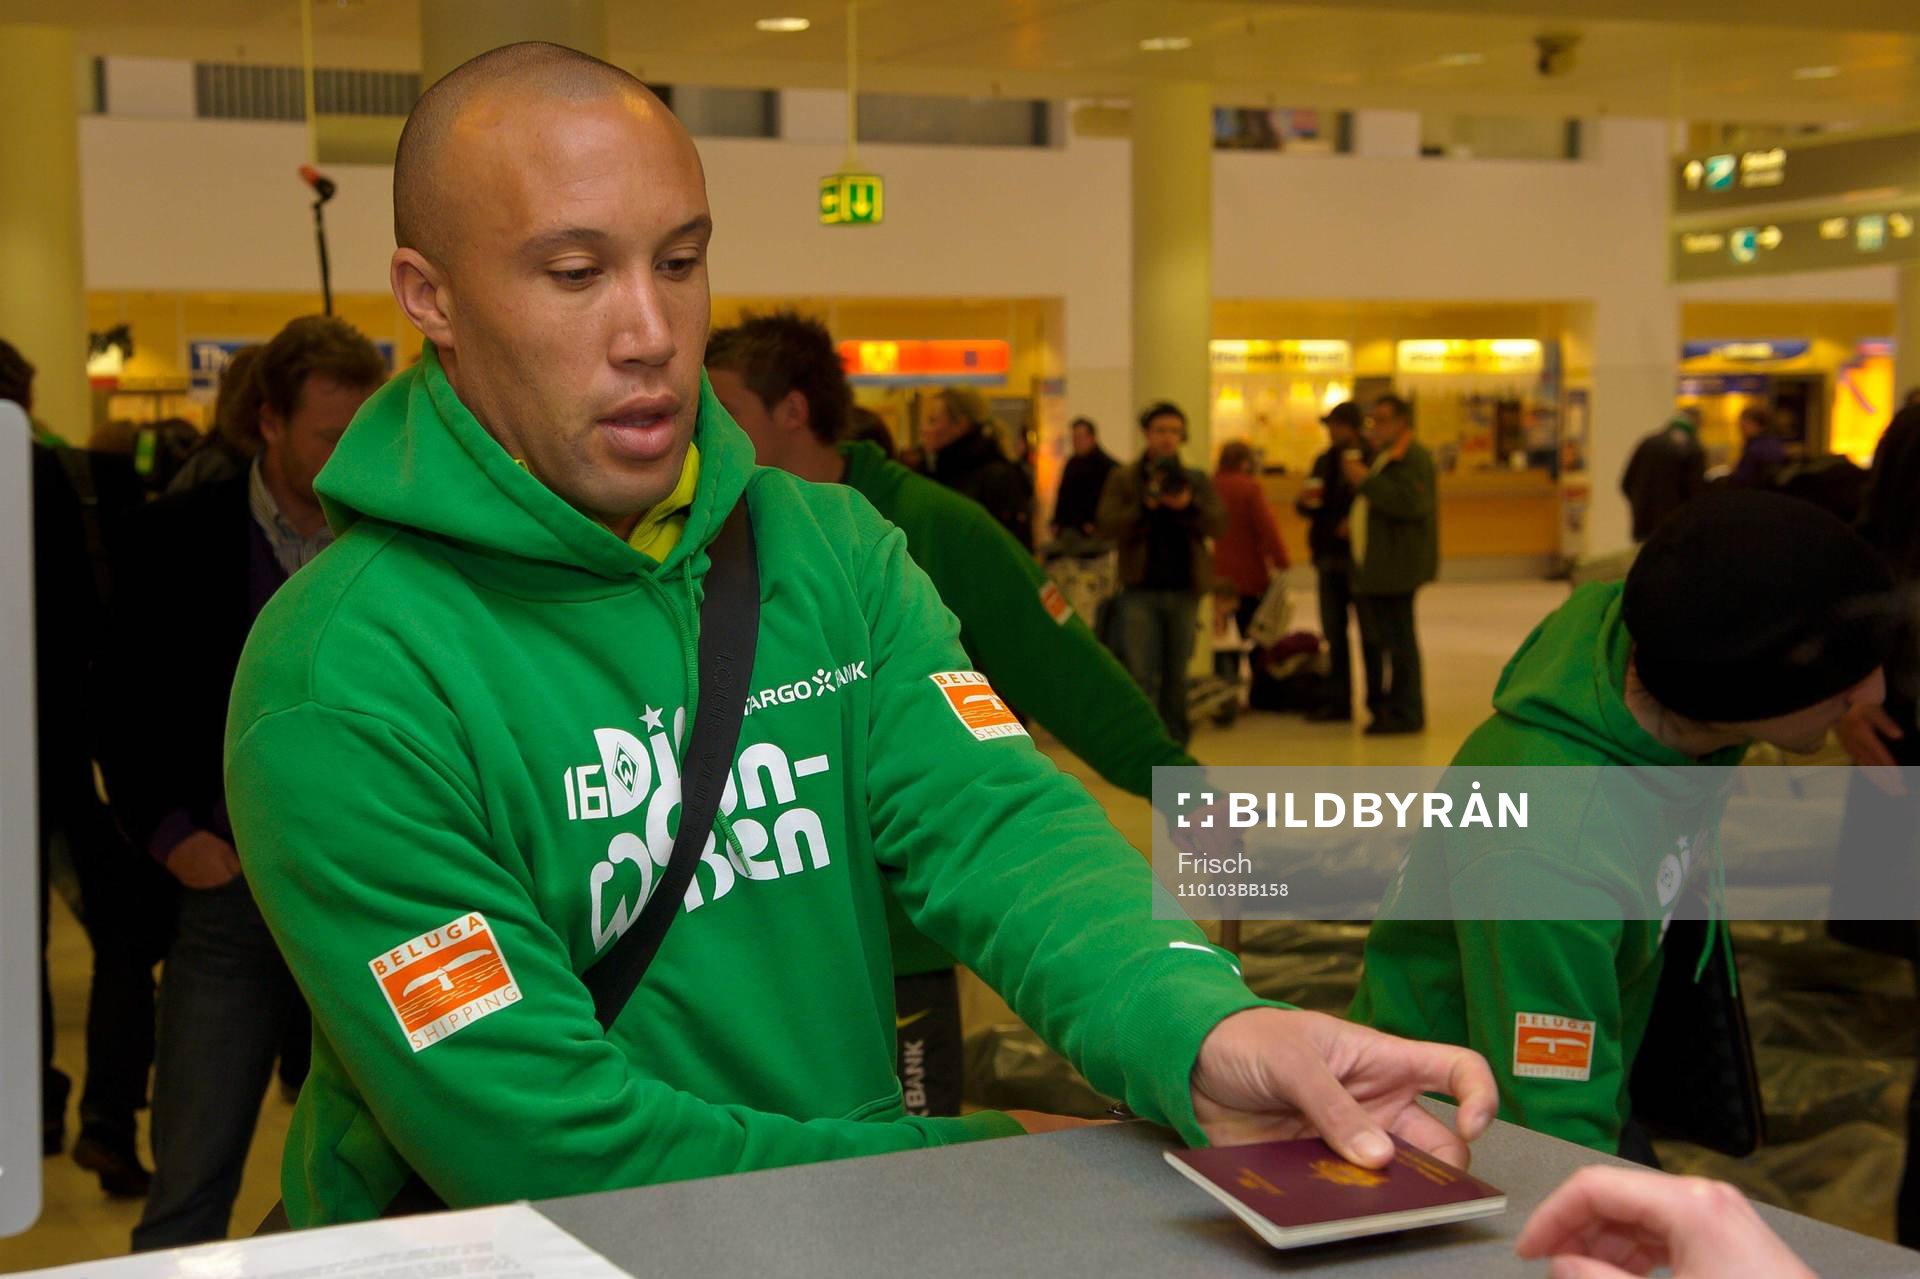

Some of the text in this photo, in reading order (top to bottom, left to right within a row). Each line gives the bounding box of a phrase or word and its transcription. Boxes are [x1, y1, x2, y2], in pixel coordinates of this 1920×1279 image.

[933, 673, 988, 685] BELU
[974, 724, 1023, 739] SHIPP
[563, 765, 609, 820] 16
[373, 915, 484, 976] BELUGA
[410, 985, 519, 1049] SHIPPING
[903, 1040, 926, 1108] BANK
